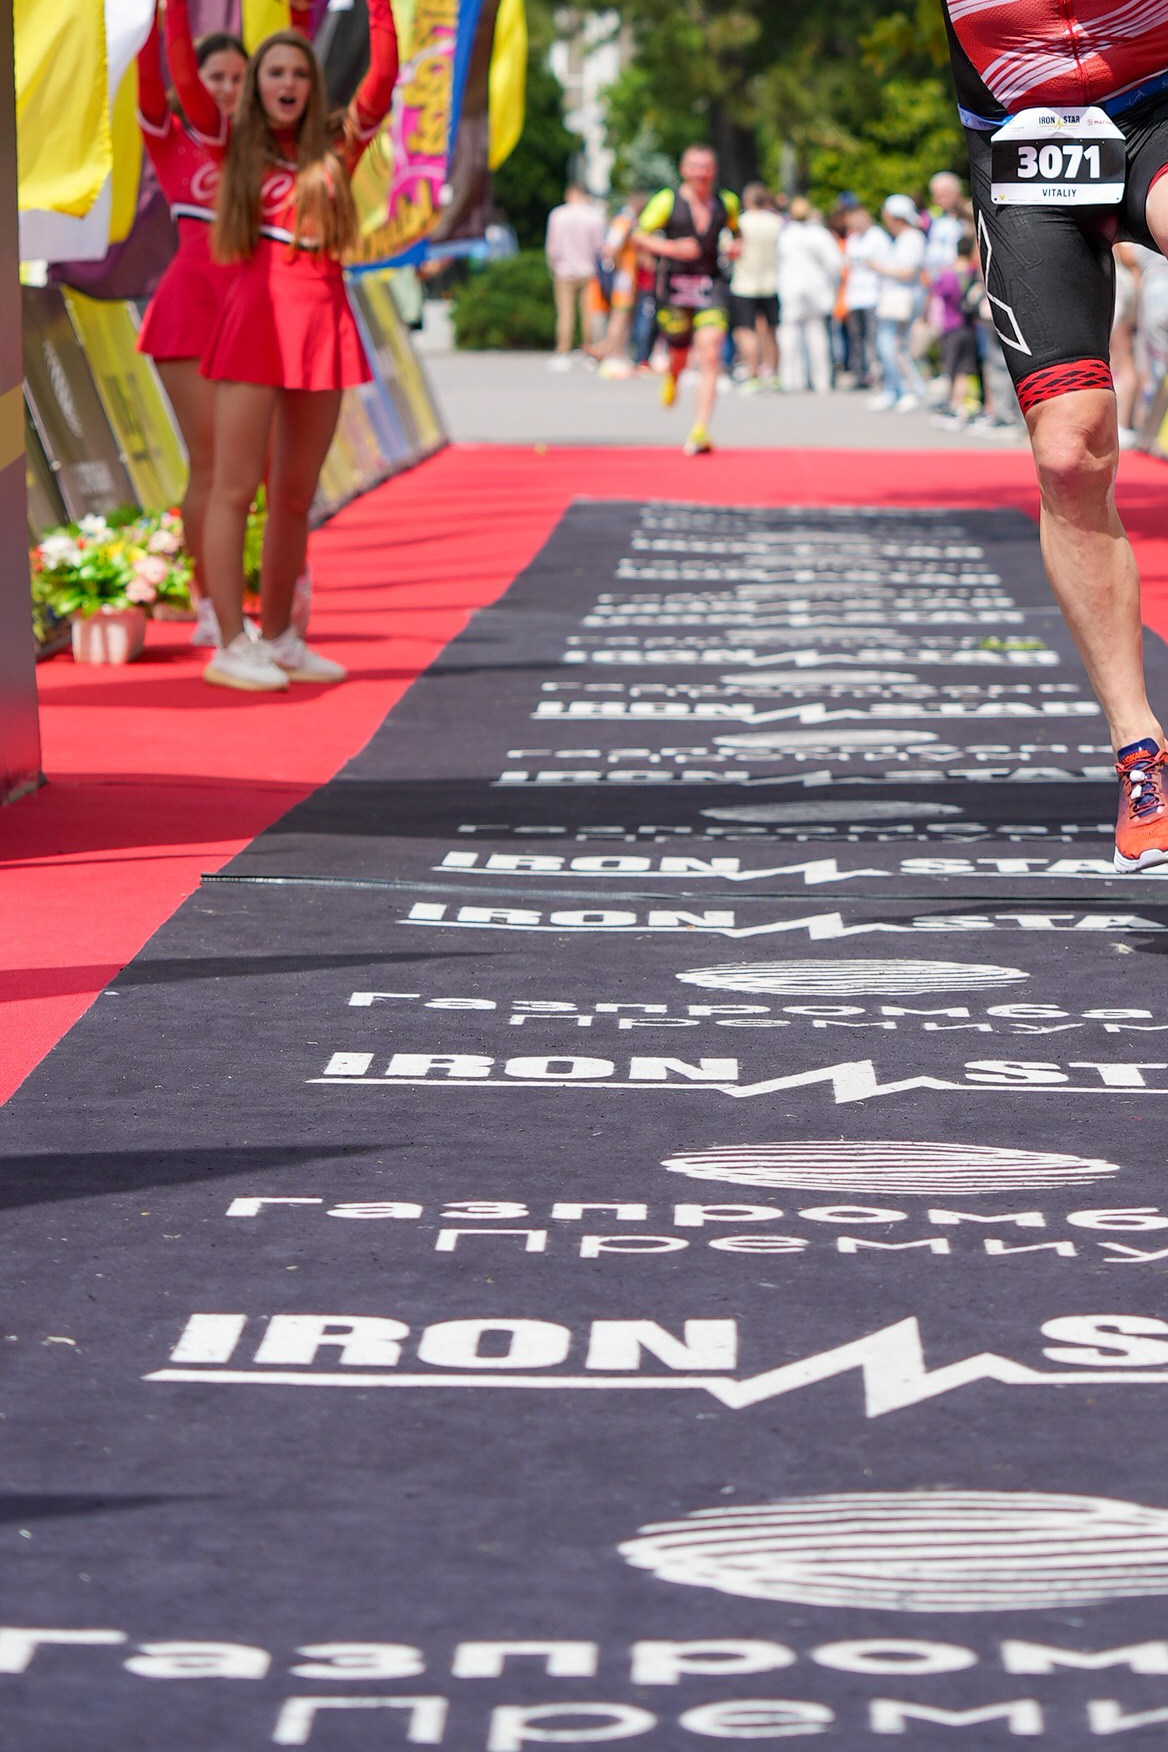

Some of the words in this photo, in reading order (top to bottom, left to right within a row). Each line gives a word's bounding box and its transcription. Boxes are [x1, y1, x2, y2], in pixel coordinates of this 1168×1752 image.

[1063, 115, 1081, 124] STAR
[1017, 145, 1101, 179] 3071
[1042, 188, 1077, 197] VITALIY
[440, 850, 740, 872] IRON
[407, 901, 735, 928] IRON
[320, 1051, 740, 1081] IRON
[166, 1313, 738, 1371] IRON
